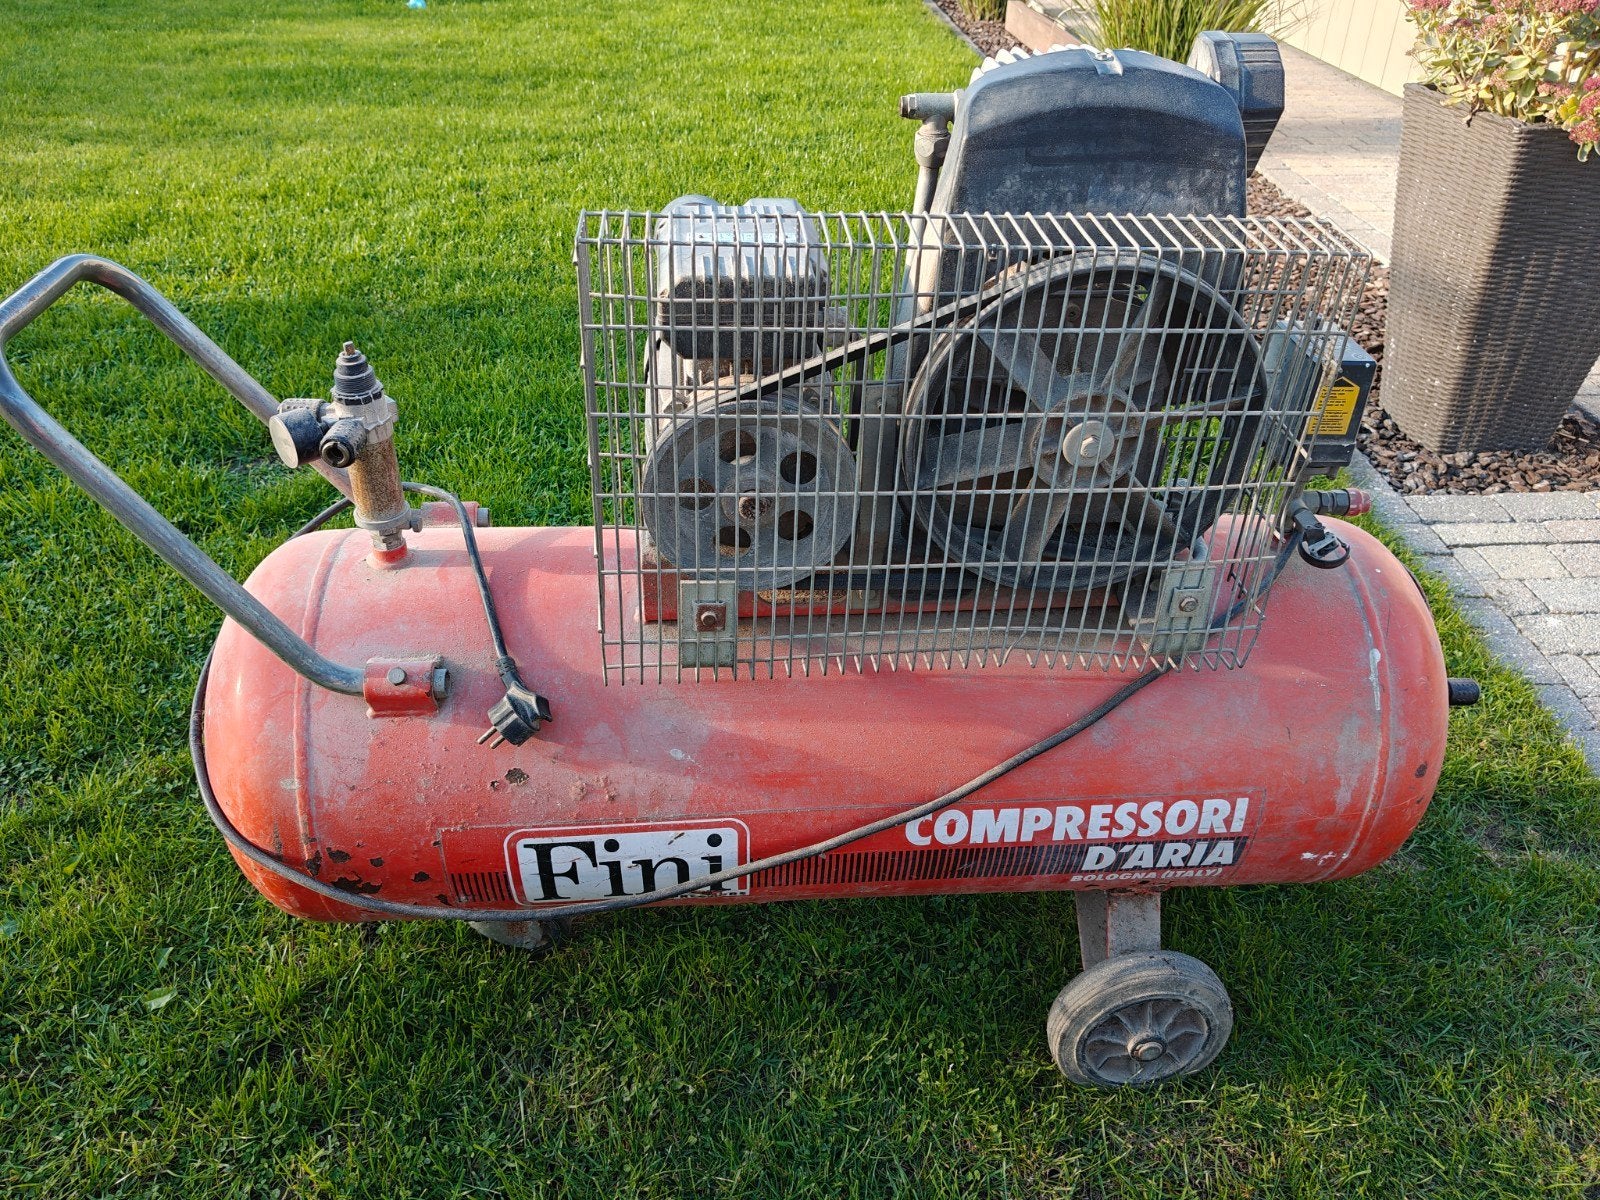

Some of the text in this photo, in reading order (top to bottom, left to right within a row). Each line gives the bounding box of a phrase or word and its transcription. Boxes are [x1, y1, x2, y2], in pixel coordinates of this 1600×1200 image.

[905, 798, 1250, 846] COMPRESSORI
[524, 833, 731, 901] Fini
[1070, 867, 1223, 882] BOLOGNA (ITALY)
[1081, 840, 1235, 871] D'ARIA
